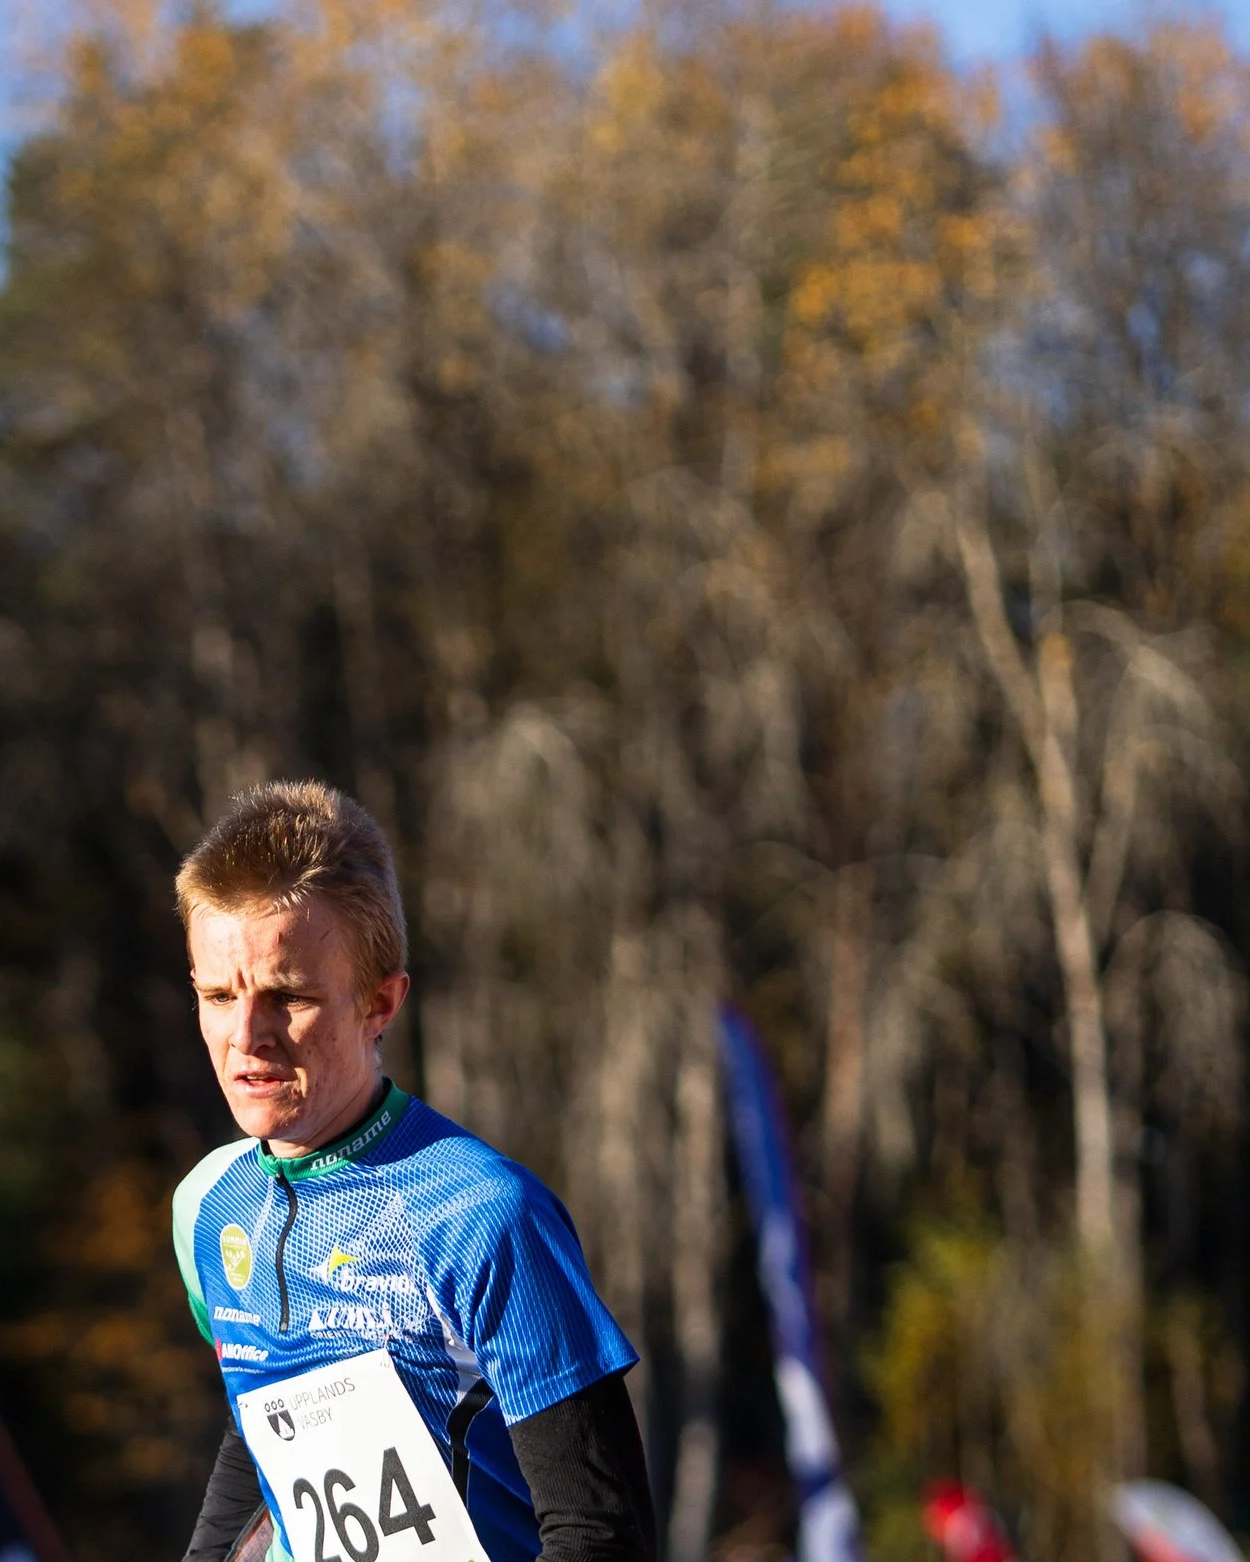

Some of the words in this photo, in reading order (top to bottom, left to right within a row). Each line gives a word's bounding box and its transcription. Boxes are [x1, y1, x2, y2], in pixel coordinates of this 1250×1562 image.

[310, 1110, 392, 1171] noname
[213, 1305, 261, 1327] noname
[289, 1377, 356, 1411] UPPLANDS
